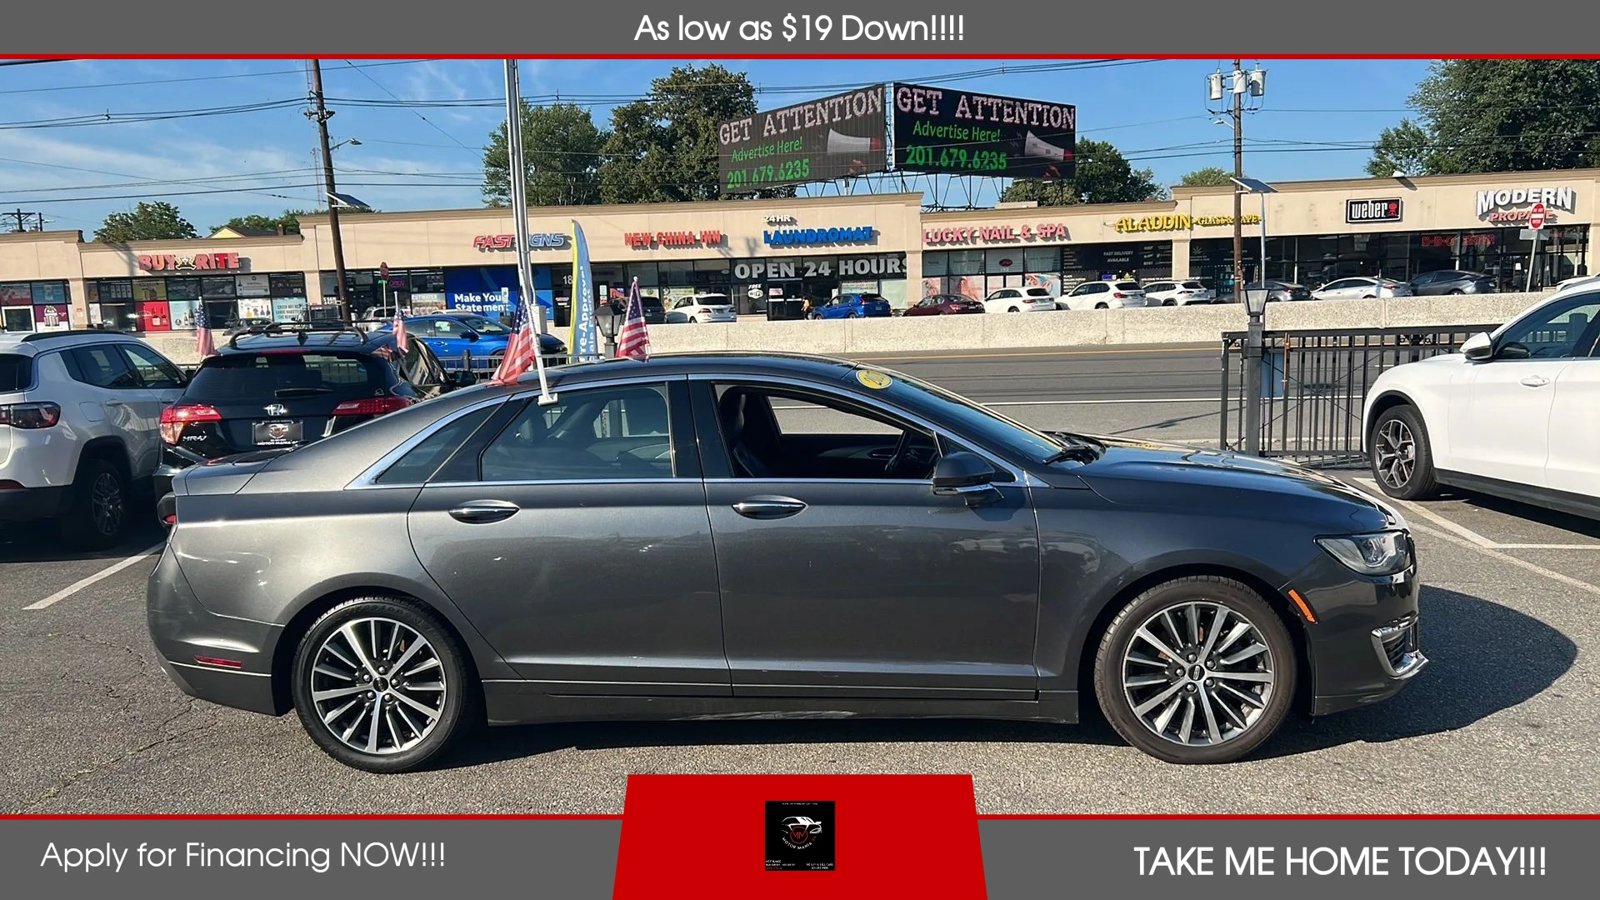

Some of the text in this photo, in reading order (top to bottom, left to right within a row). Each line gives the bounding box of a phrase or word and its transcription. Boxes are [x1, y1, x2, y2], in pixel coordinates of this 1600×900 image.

[719, 87, 883, 146] GET ATTENTION
[896, 87, 1075, 130] GET ATTENTION
[912, 120, 1001, 142] Advertise Here!
[731, 136, 803, 163] Advertise Here!
[905, 145, 1007, 170] 201.679.6235
[727, 159, 810, 189] 201.679.6235
[1351, 200, 1388, 219] weber
[1476, 187, 1572, 217] MODERN
[1115, 214, 1192, 233] ALADDIN
[1488, 208, 1554, 222] PROPAE
[473, 233, 565, 249] FASTGNS
[624, 229, 721, 247] NEW CHINA INN
[763, 226, 873, 245] LAUNDROMAT
[922, 222, 1067, 243] LUCKY NAIL & SPA
[138, 252, 241, 271] BUY RITE
[734, 261, 796, 280] OPEN
[804, 260, 832, 277] 24
[454, 292, 502, 303] Make You
